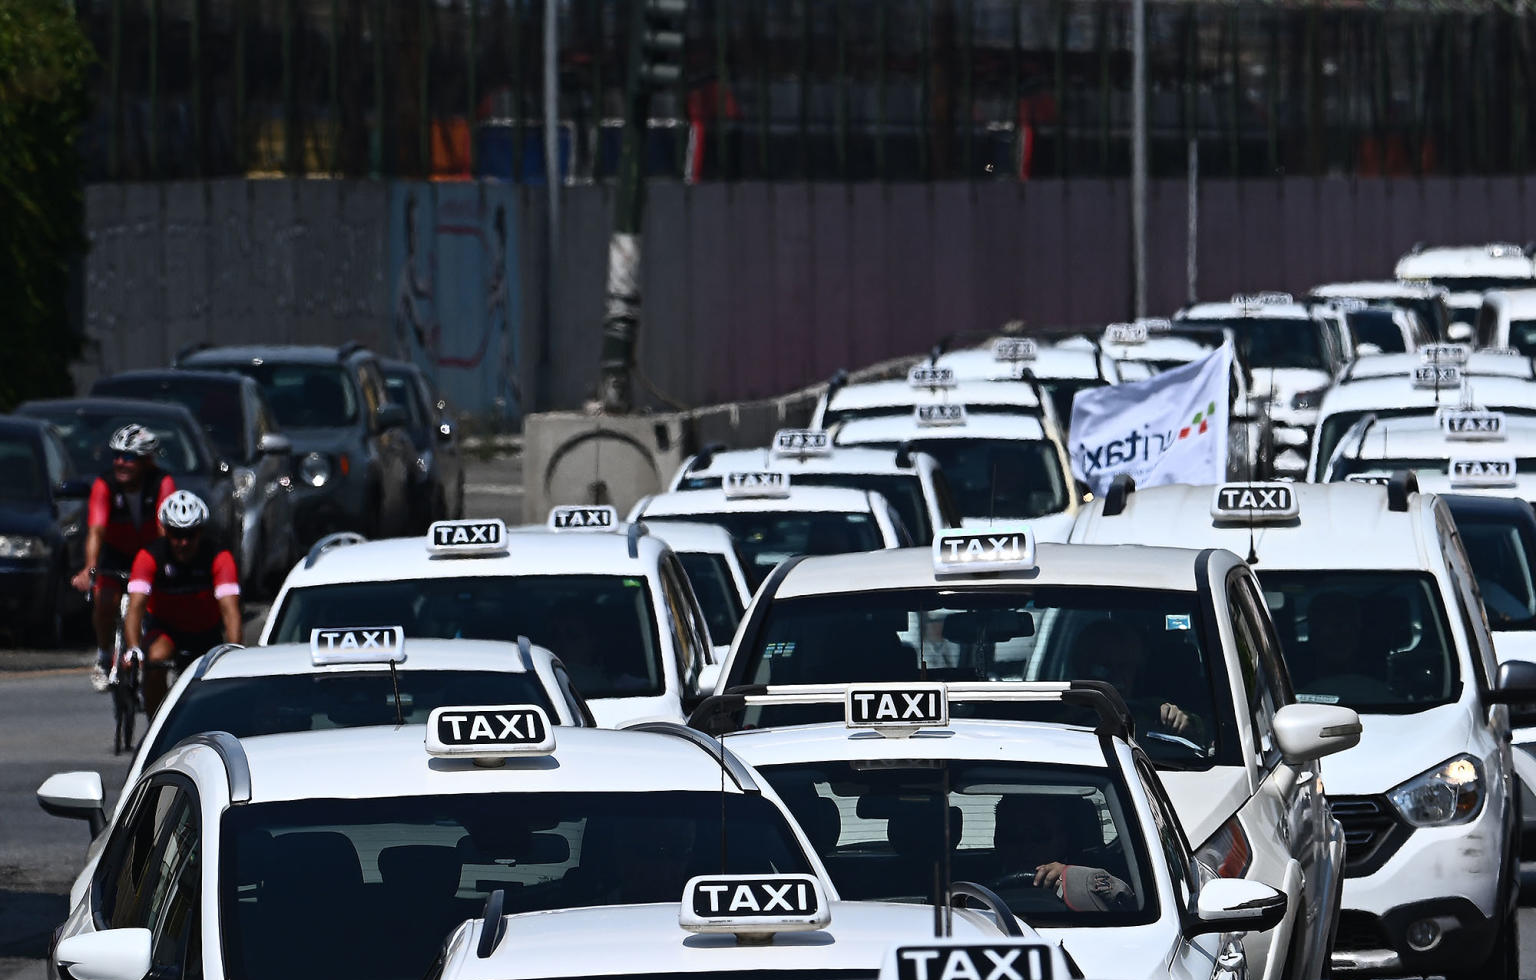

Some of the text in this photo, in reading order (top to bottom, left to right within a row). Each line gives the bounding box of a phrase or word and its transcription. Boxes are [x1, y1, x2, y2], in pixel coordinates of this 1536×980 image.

[1450, 417, 1499, 432] TAXI
[1456, 462, 1510, 476] TAXI
[734, 473, 783, 487] TAXI
[1222, 489, 1286, 508] TAXI
[555, 511, 610, 527] TAXI
[436, 526, 496, 544] TAXI
[944, 536, 1020, 561] TAXI
[321, 631, 390, 649] TAXI
[854, 693, 936, 720] TAXI
[442, 713, 536, 740] TAXI
[699, 883, 808, 912] TAXI
